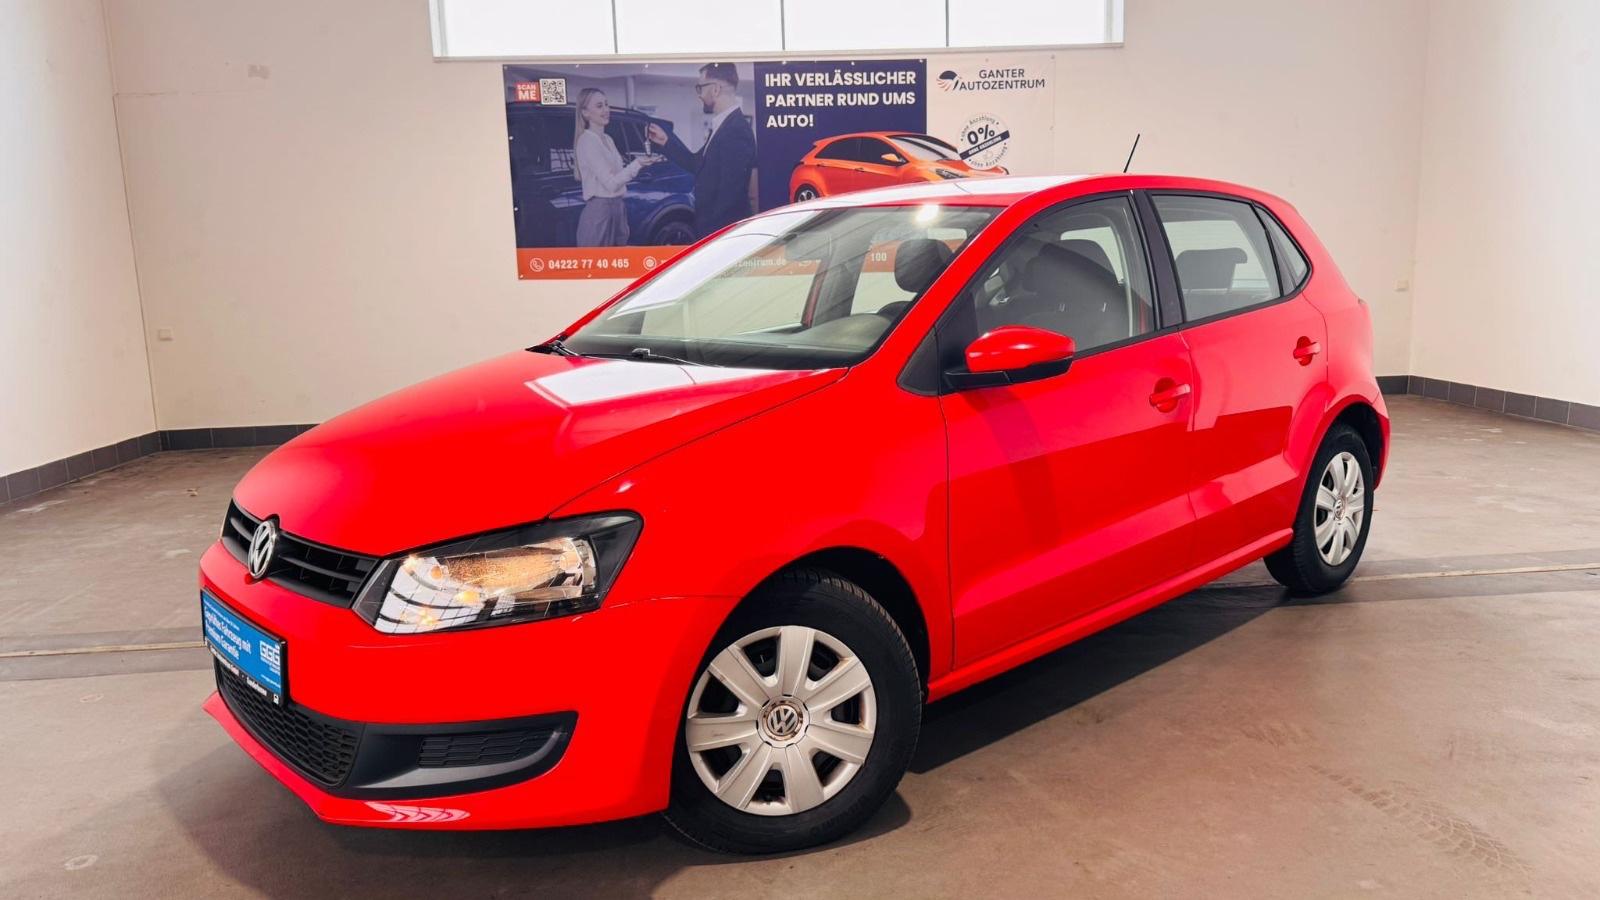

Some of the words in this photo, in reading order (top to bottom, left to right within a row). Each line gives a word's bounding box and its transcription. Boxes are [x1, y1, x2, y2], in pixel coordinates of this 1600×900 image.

[765, 73, 791, 87] IHR
[795, 69, 916, 87] VERLÄSSLICHER
[978, 68, 1025, 79] GANTER
[959, 79, 1046, 91] AUTOZENTRUM
[518, 90, 537, 100] ME
[765, 94, 834, 108] PARTNER
[837, 93, 880, 107] RUND
[883, 92, 916, 105] UMS
[766, 114, 814, 128] AUTO!
[967, 124, 996, 145] 0%
[548, 259, 578, 270] 04222
[581, 259, 593, 269] 77
[596, 259, 609, 269] 40
[611, 258, 630, 268] 465
